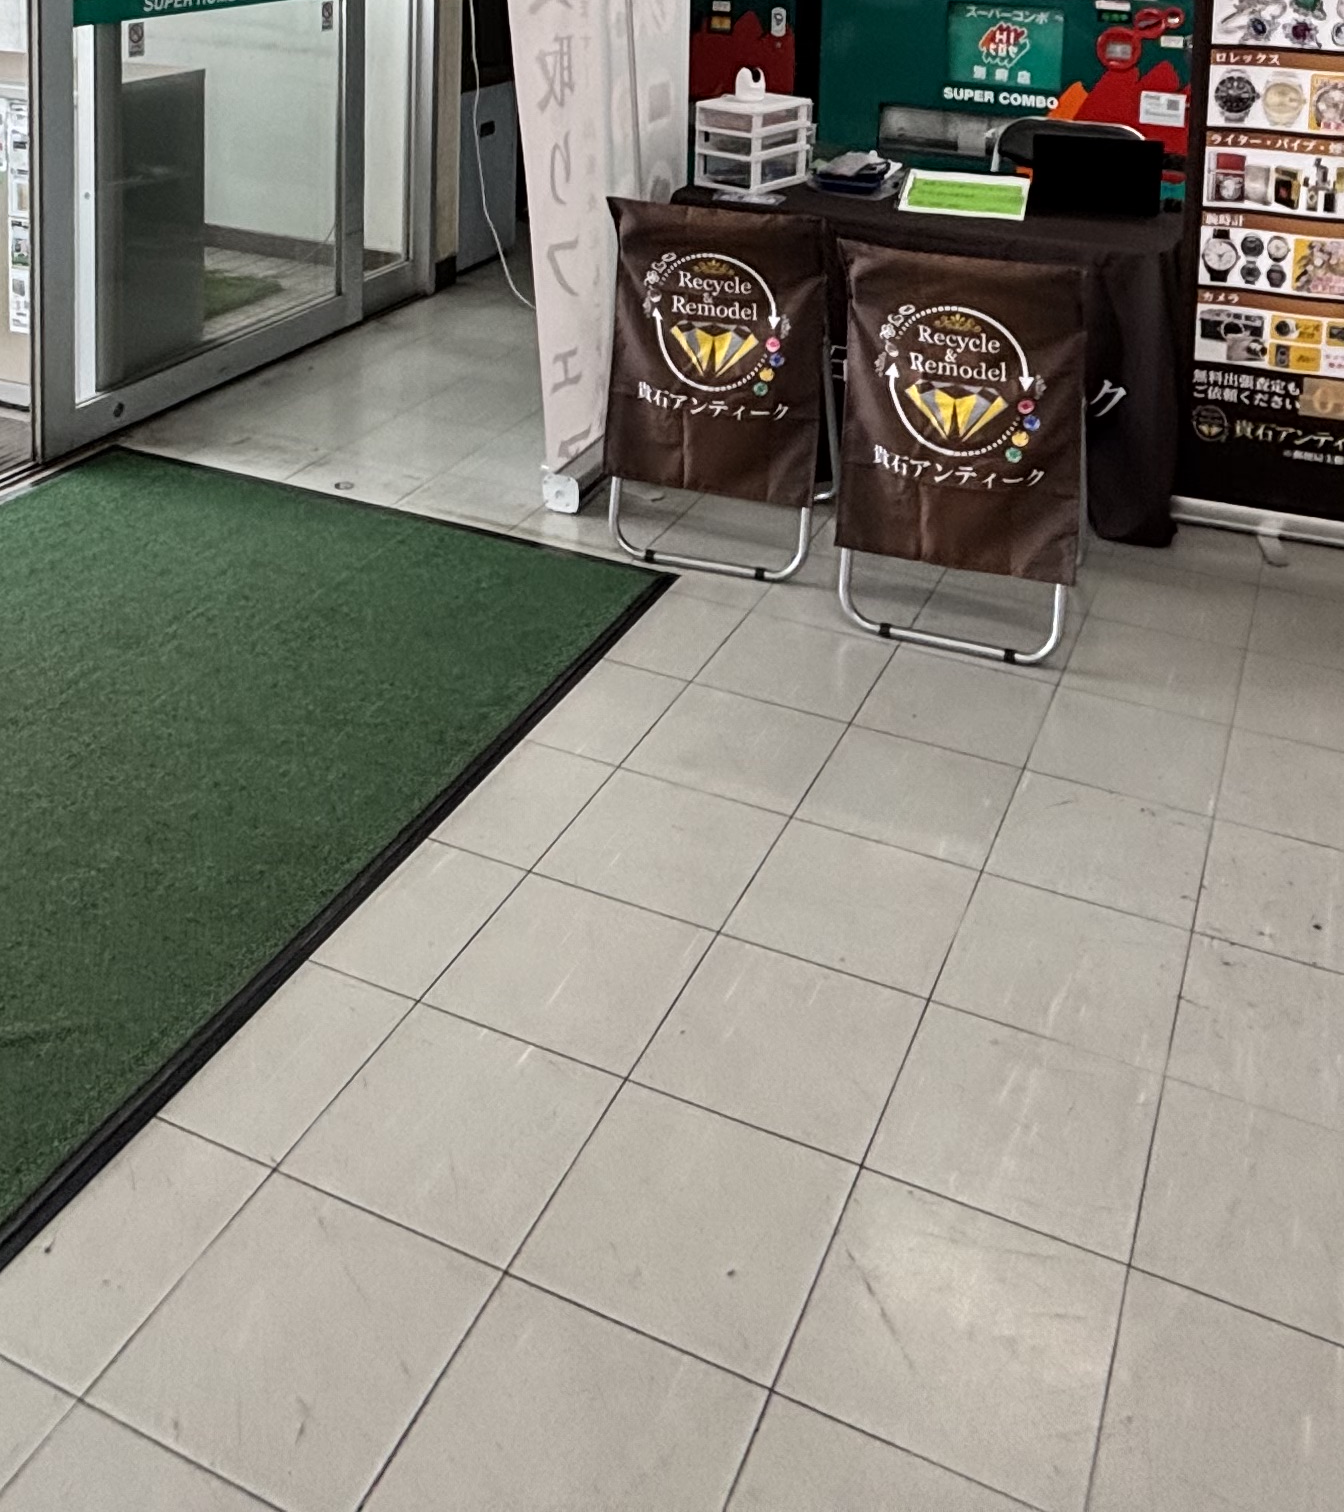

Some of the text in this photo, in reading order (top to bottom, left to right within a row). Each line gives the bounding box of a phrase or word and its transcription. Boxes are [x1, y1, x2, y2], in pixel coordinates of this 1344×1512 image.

[1214, 51, 1281, 66] ロレックス
[943, 87, 1059, 110] SUPER COMBO
[678, 270, 752, 296] Recycle
[671, 294, 757, 321] Remodel
[1202, 292, 1240, 304] カメラ
[917, 324, 1001, 354] Recycle
[909, 352, 1007, 383] Remodel
